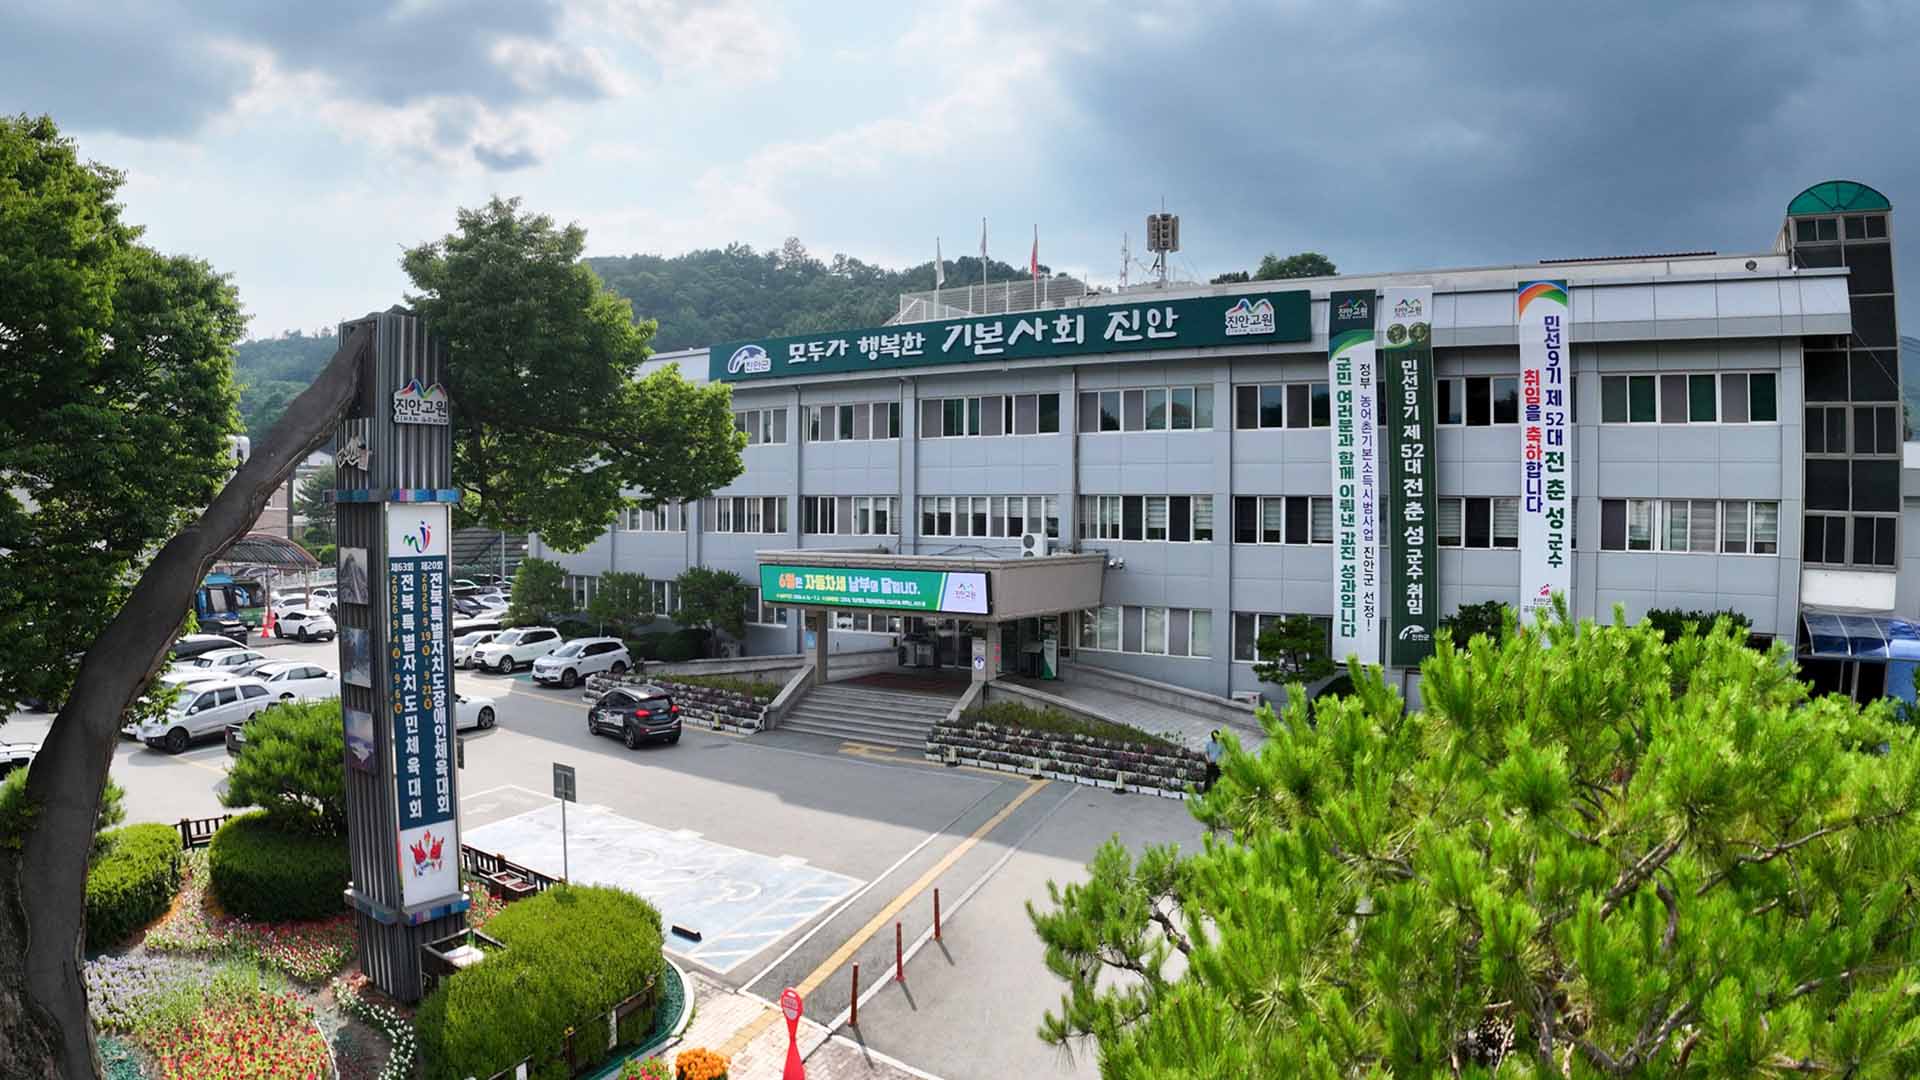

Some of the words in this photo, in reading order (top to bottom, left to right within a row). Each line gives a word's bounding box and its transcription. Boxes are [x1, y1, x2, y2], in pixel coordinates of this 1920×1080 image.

[788, 339, 849, 364] 모두가
[857, 331, 926, 360] 행복한
[942, 313, 1085, 355] 기본사회
[1103, 307, 1179, 342] 진안
[1227, 313, 1273, 328] 진안고원
[1544, 315, 1561, 384] 민선9기
[1336, 357, 1353, 386] 군민
[1359, 363, 1371, 389] 정부
[1400, 359, 1419, 421] 민선9기
[395, 398, 447, 418] 진안고원
[1524, 368, 1541, 422] 취임을
[1337, 390, 1354, 447] 여러분과
[1338, 451, 1355, 479] 함께
[1525, 426, 1543, 513] 축하합니다
[1339, 484, 1355, 527] 이뤄낸
[391, 562, 414, 572] 제63회
[421, 560, 443, 570] 제20회
[1363, 546, 1374, 586] 진안군
[1547, 533, 1563, 568] 군수
[1340, 564, 1356, 638] 성과입니다
[1363, 592, 1374, 632] 선정!
